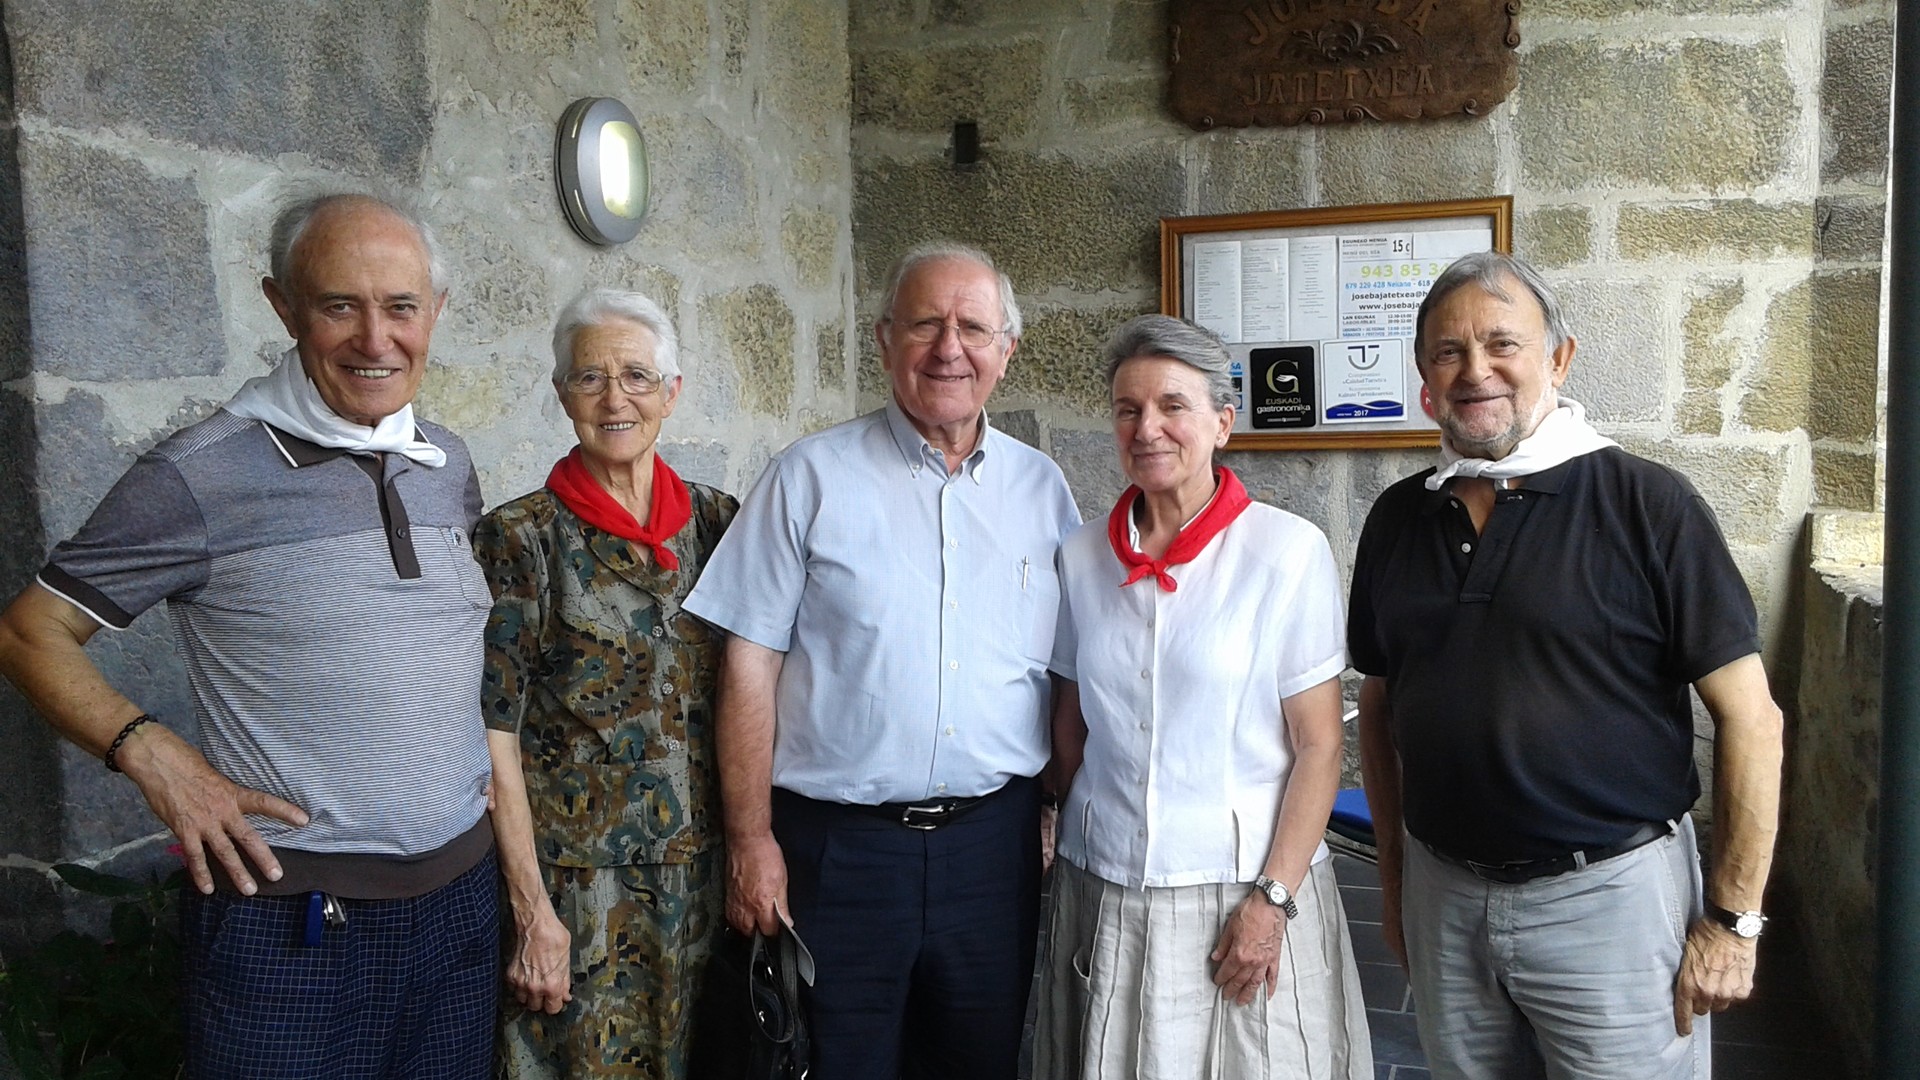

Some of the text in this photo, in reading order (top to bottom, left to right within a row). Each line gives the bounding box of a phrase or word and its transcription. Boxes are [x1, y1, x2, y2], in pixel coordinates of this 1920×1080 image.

[1250, 64, 1436, 105] JATETXEA
[1392, 239, 1403, 253] 15
[1361, 264, 1394, 278] 943
[1400, 263, 1422, 277] 85
[1417, 279, 1431, 287] 618
[1265, 397, 1302, 405] EUSKADI
[1256, 404, 1311, 414] gastronomika
[1353, 409, 1369, 417] 2017
